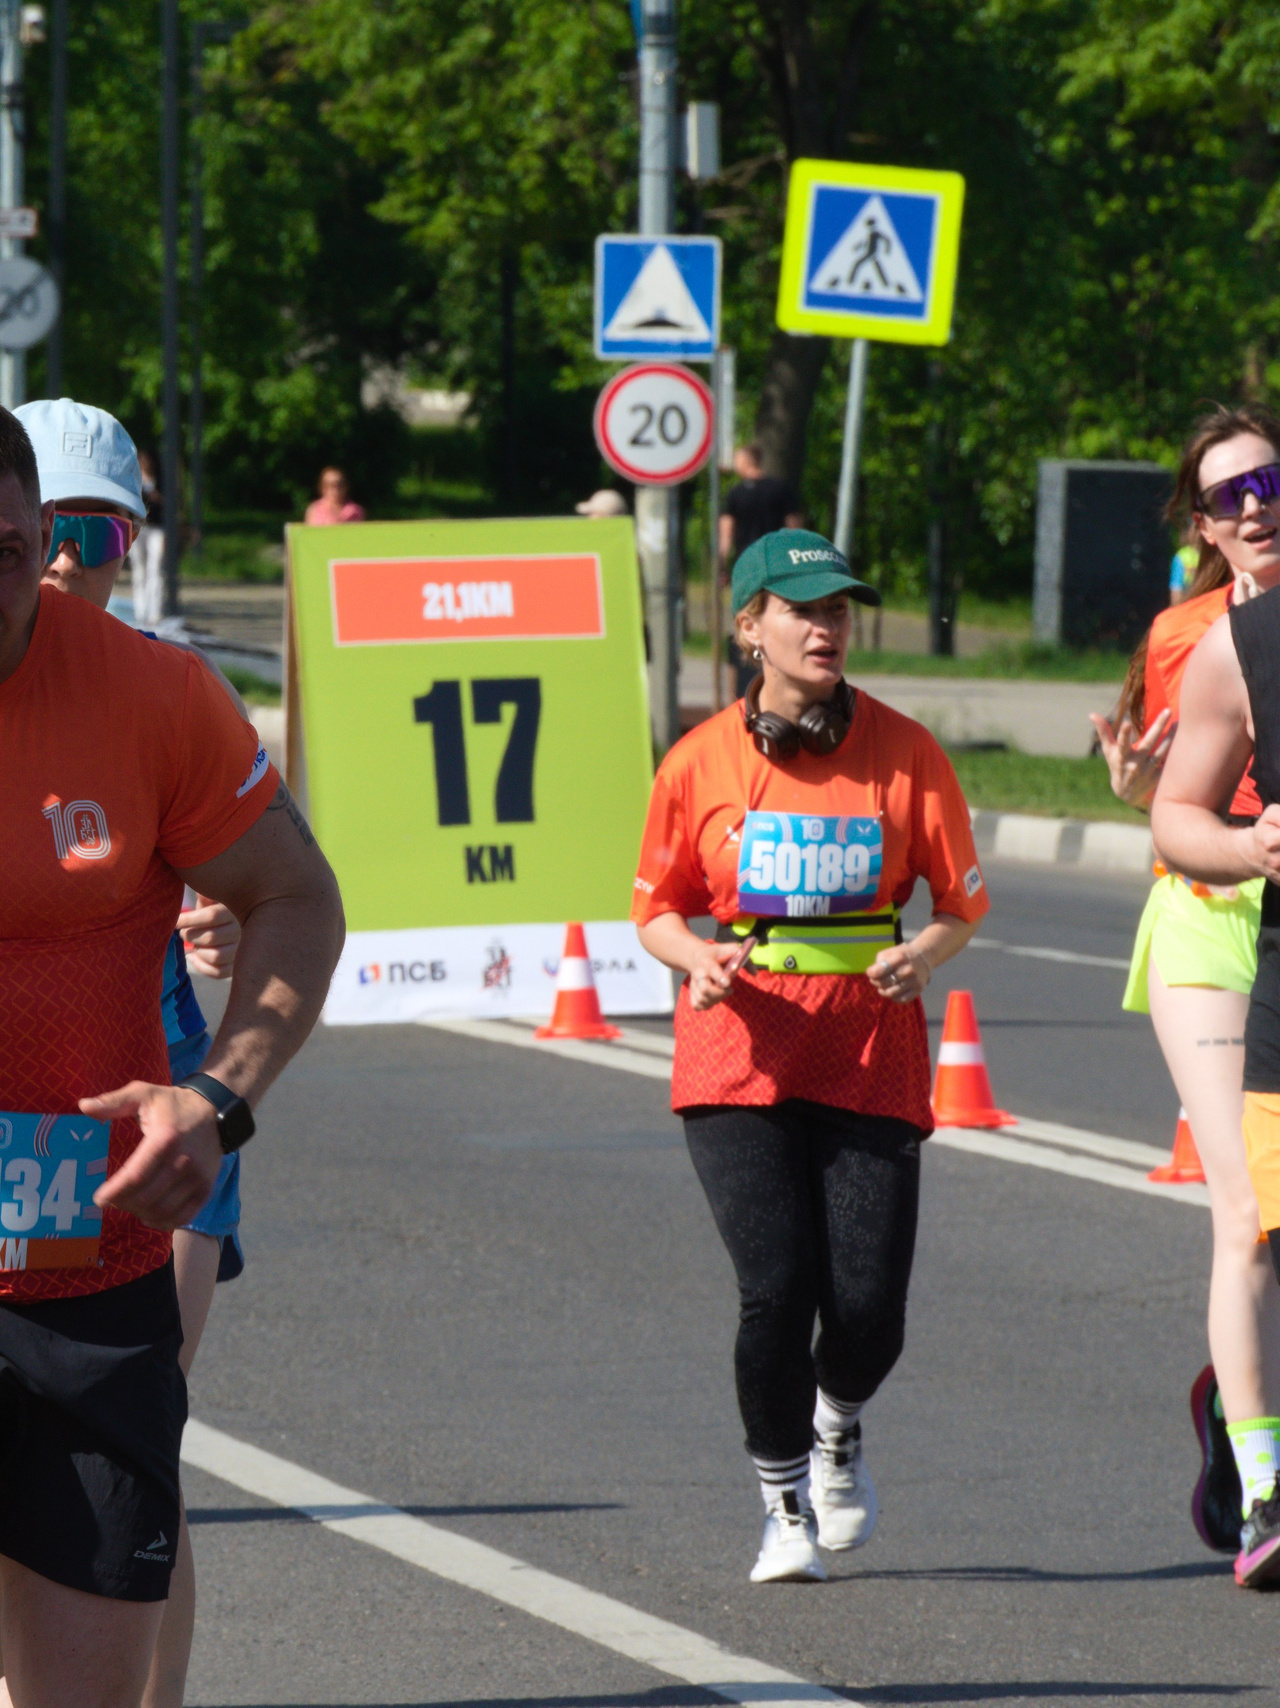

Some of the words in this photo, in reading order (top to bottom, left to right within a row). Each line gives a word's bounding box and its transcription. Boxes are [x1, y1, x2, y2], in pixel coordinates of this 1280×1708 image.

[629, 402, 688, 447] 20
[413, 676, 542, 827] 17
[41, 799, 112, 860] 10
[801, 818, 825, 841] 10
[464, 844, 516, 884] KM
[749, 840, 871, 893] 50189
[388, 960, 447, 983] ПСБ
